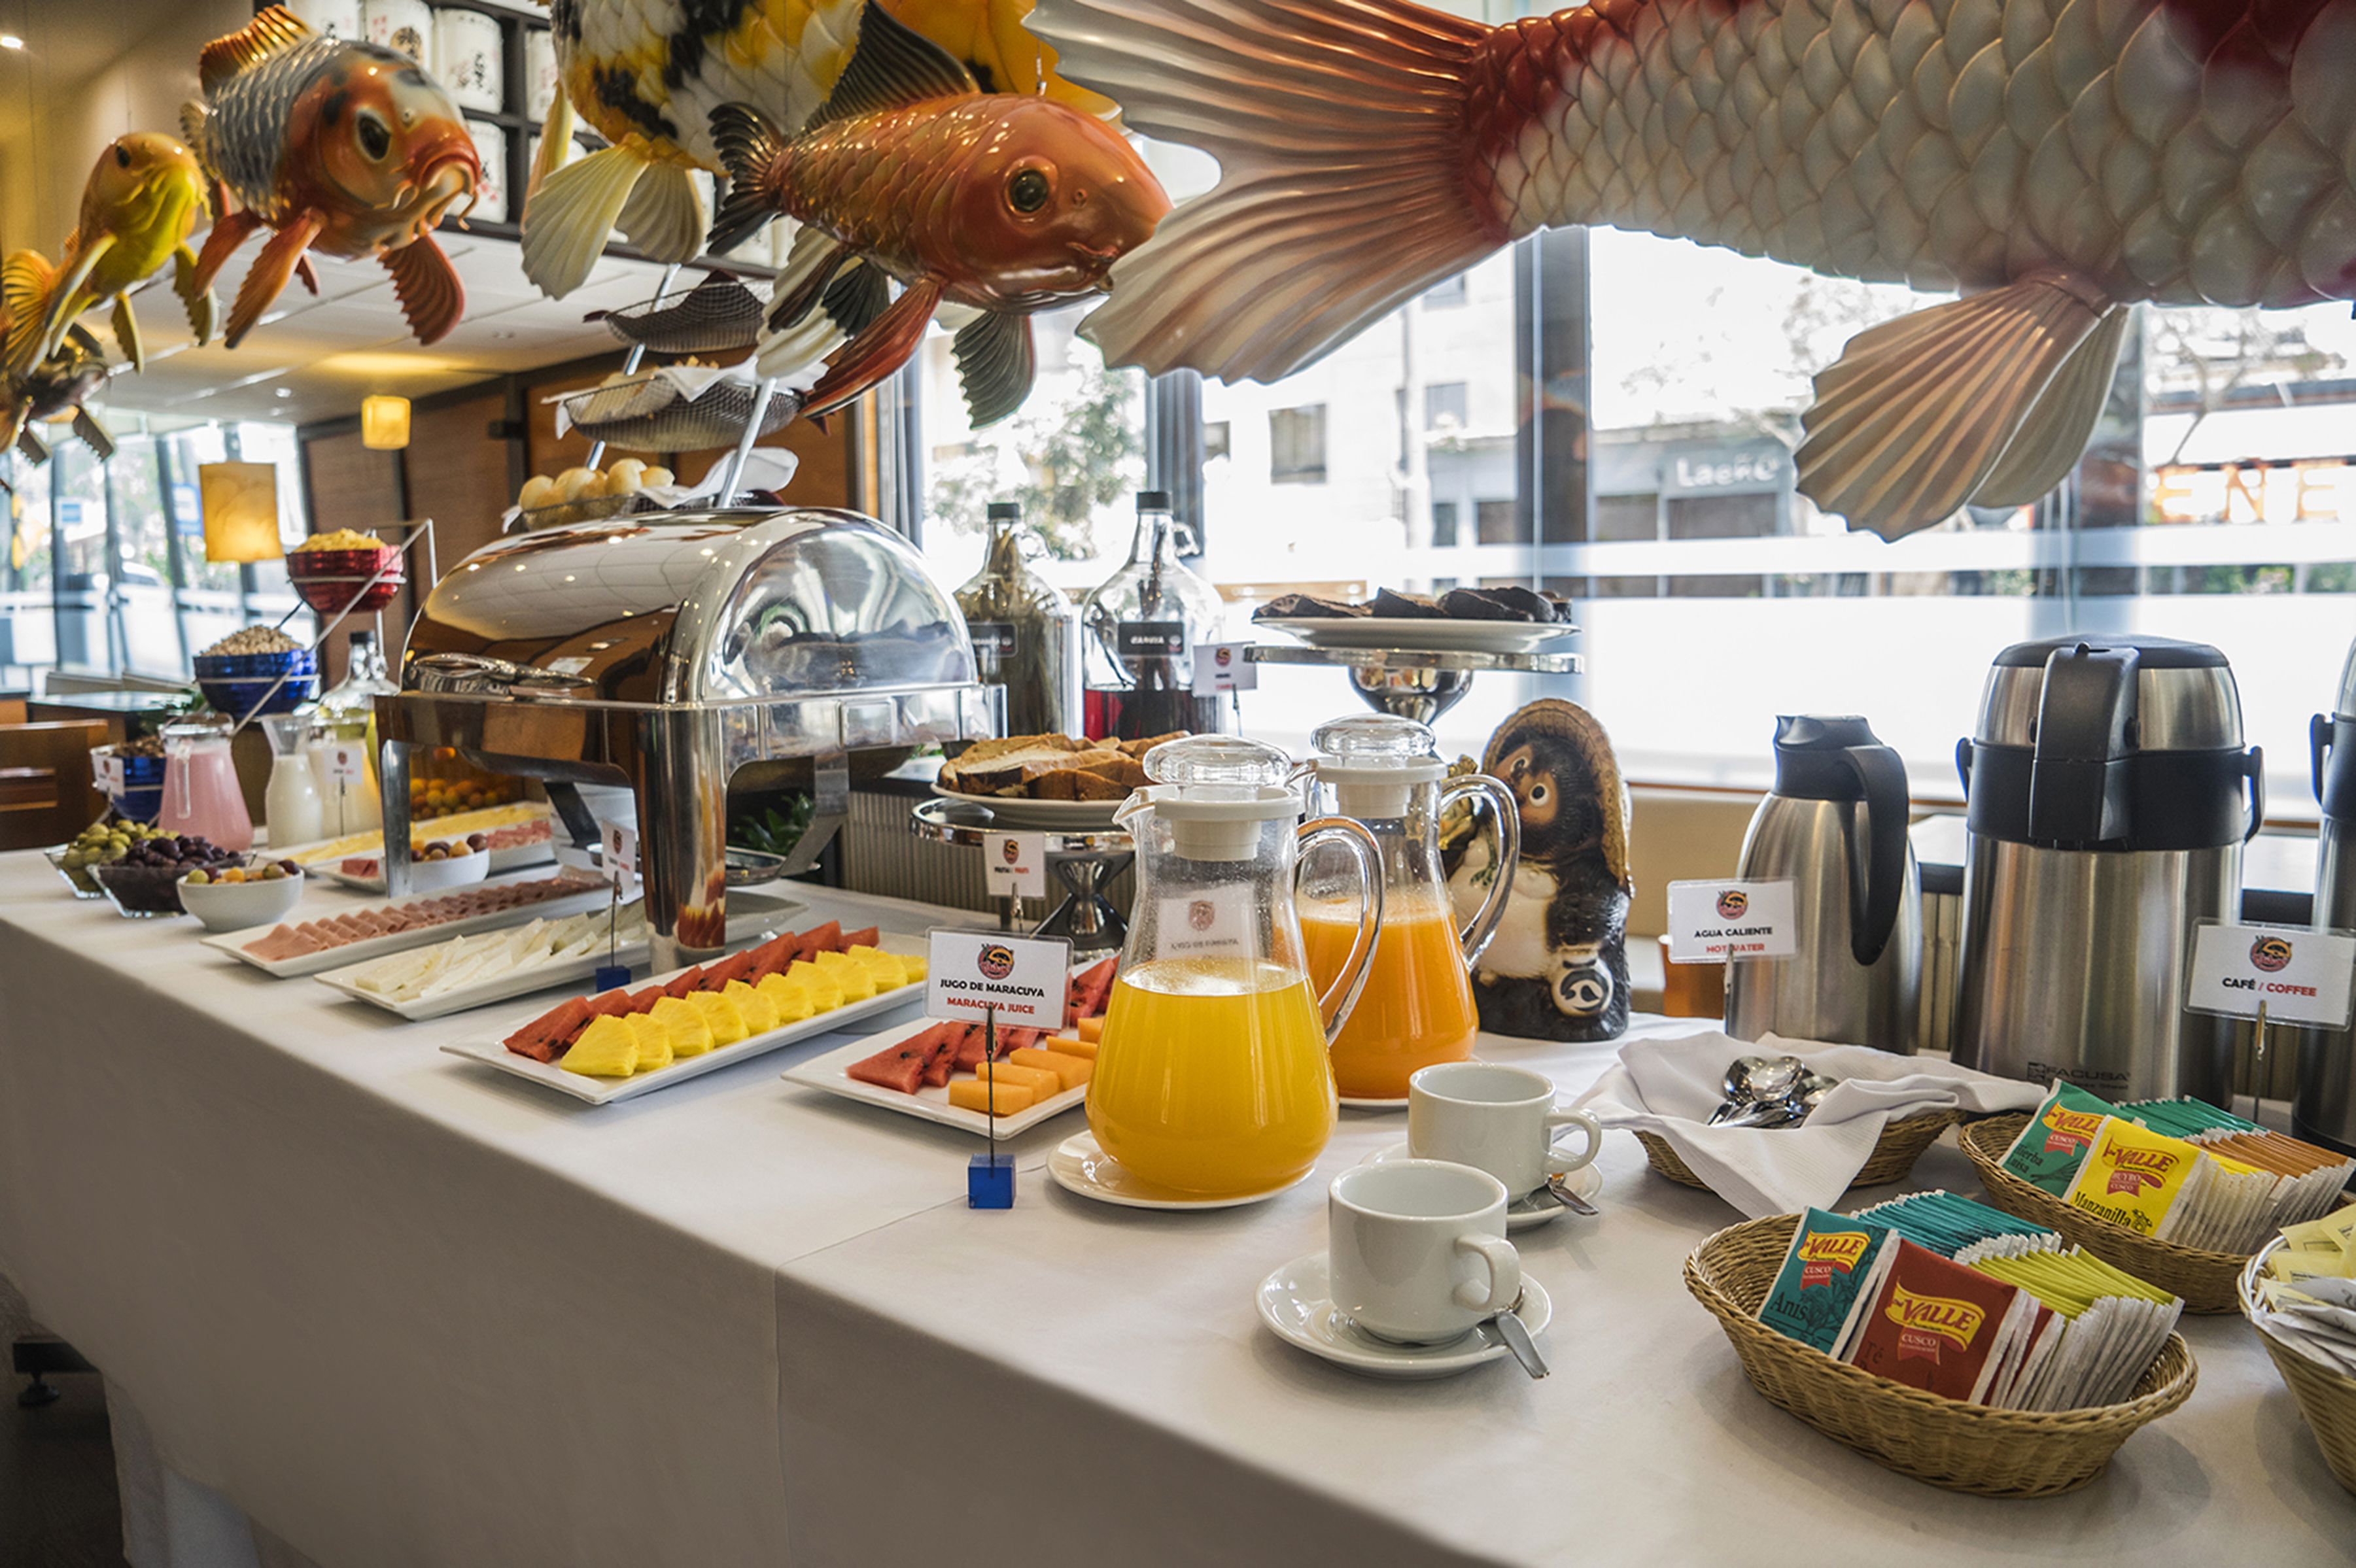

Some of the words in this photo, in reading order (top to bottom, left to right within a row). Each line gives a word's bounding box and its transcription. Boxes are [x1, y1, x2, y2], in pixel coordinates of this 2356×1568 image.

[1694, 929, 1723, 938] AGUA
[1725, 927, 1773, 936] CALIENTE
[940, 979, 967, 989] JUGO
[969, 981, 984, 991] DE
[986, 983, 1045, 997] MARACUYA
[2223, 977, 2256, 990] CAFÉ
[2266, 983, 2317, 997] COFFEE
[946, 997, 1005, 1012] MARACUYA
[1007, 1004, 1035, 1014] JUICE
[2115, 1148, 2174, 1173] VALLE
[2074, 1191, 2132, 1227] Manzanilla
[1809, 1237, 1863, 1255] VALLE
[1805, 1265, 1831, 1274] CUSCO
[1903, 1299, 1975, 1331] VALLE
[1901, 1333, 1936, 1347] CUSCO
